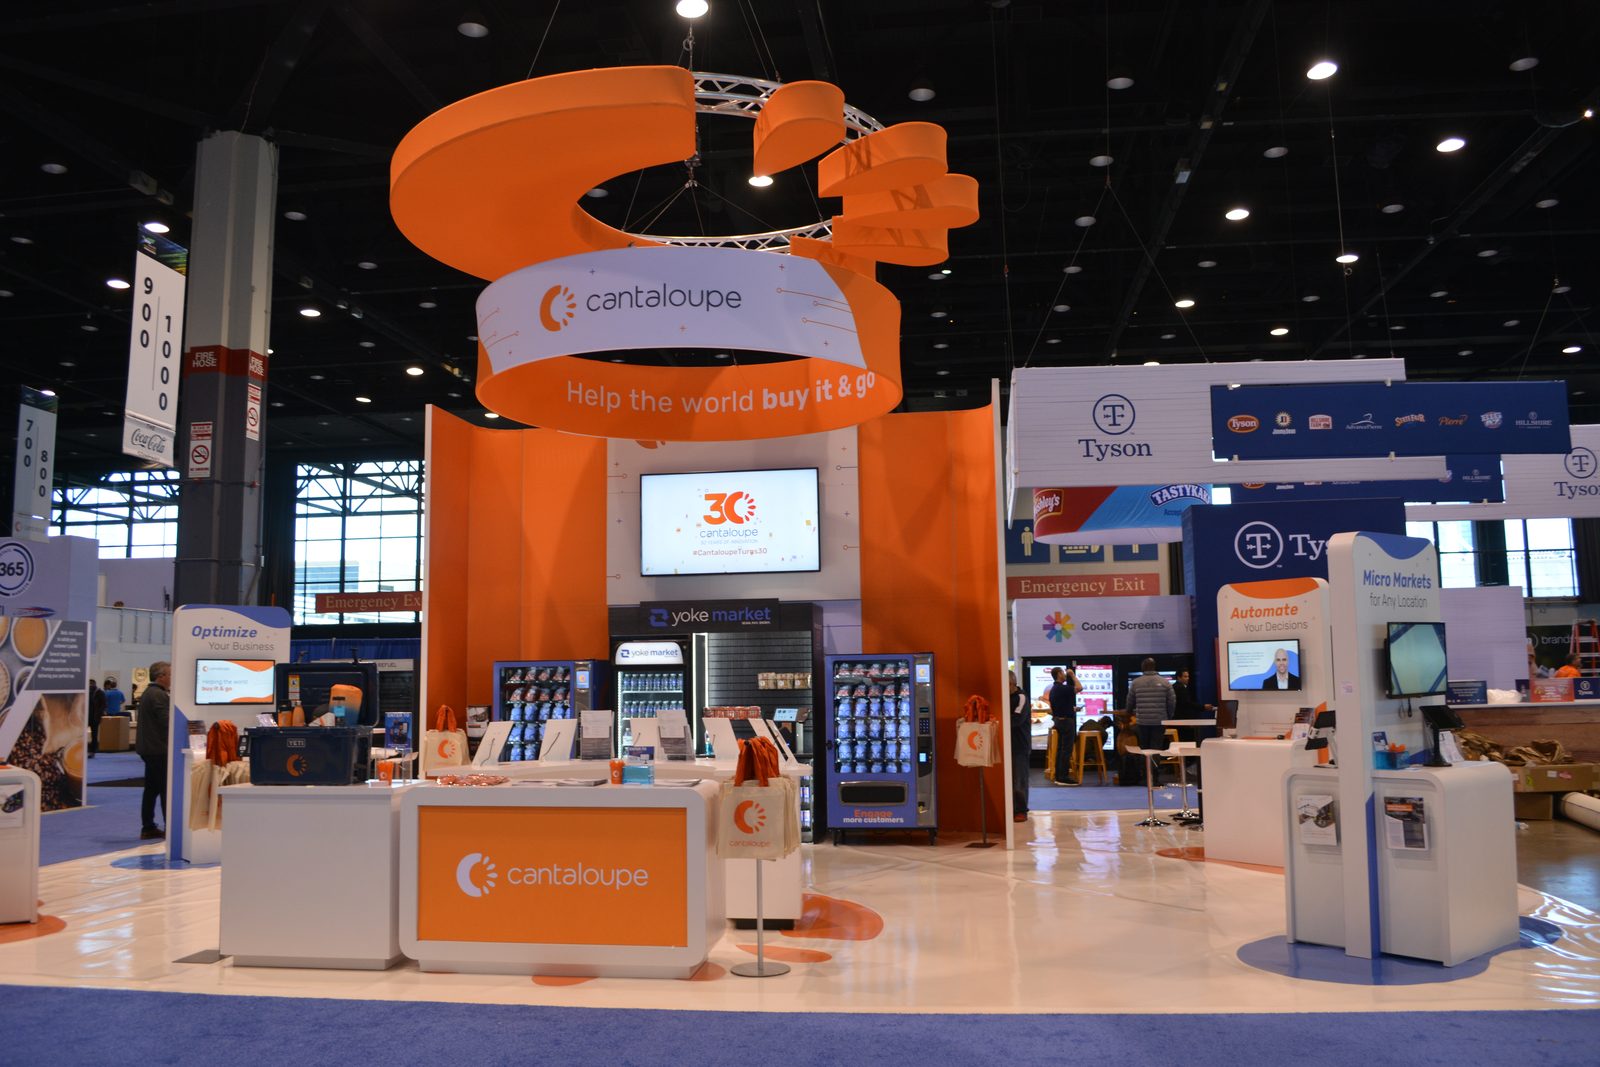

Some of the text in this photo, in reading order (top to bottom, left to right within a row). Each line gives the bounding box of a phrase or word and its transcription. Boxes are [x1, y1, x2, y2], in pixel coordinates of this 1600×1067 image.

[586, 283, 741, 311] cantaloupe
[192, 359, 217, 367] HOSE
[195, 352, 215, 360] FIRE
[250, 356, 263, 369] FIRE
[567, 371, 875, 413] Help the world buy it & go
[1231, 418, 1257, 430] Tyson
[1078, 438, 1152, 462] Tyson
[1151, 484, 1209, 505] TASTYKAK
[700, 527, 759, 538] cantaloupe
[0, 562, 24, 576] 365
[1020, 577, 1145, 596] Emergency Exit
[1363, 569, 1432, 589] Micro Markets
[326, 593, 422, 611] Emergency Ex
[1369, 592, 1428, 610] for Any Location
[672, 607, 771, 626] yoke market
[1230, 603, 1299, 620] Automate
[191, 625, 258, 640] Optimize
[1081, 620, 1165, 631] Cooler Screens
[1244, 621, 1308, 633] Your Decisions
[208, 641, 275, 651] Your Business
[631, 649, 649, 657] yoke
[854, 809, 893, 818] Engage
[507, 862, 649, 890] cantaloupe
